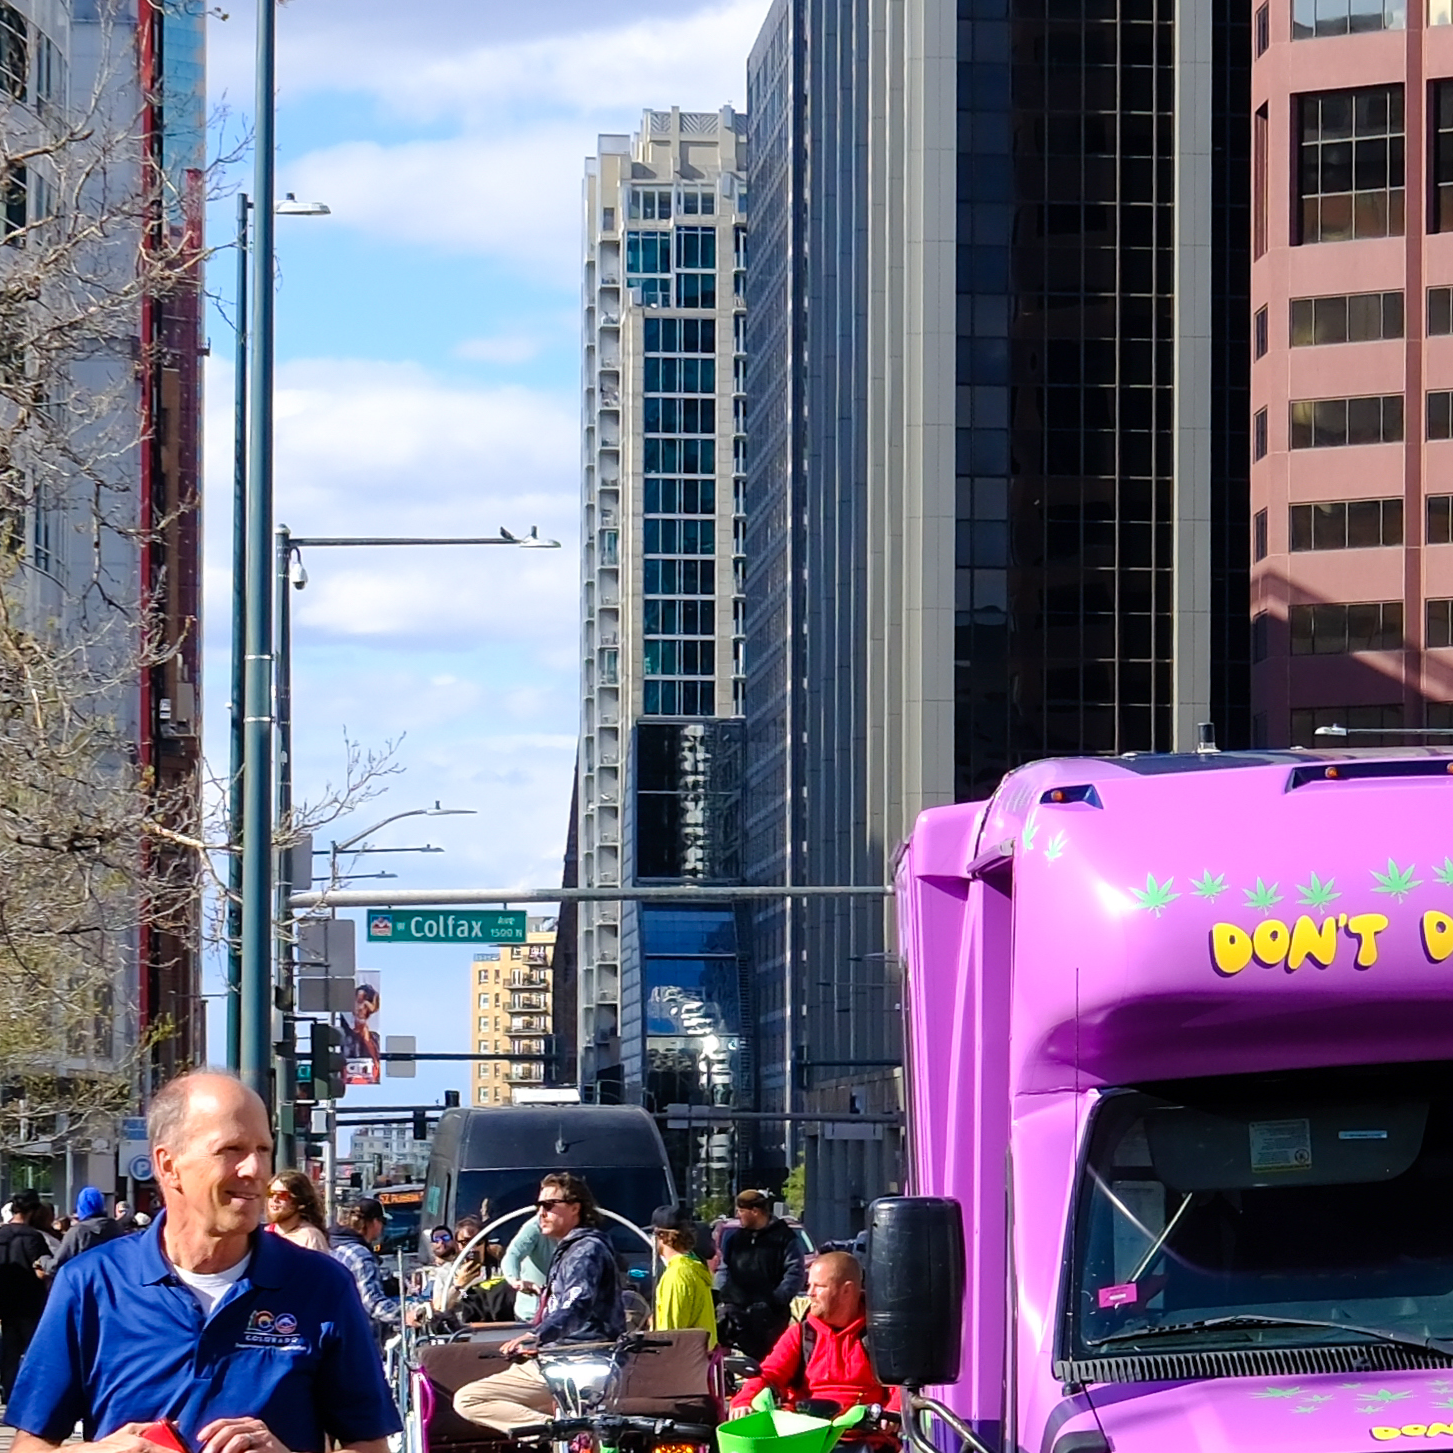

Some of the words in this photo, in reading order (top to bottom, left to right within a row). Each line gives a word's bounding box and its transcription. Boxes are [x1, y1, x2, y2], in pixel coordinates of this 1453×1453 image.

[410, 914, 483, 938] Colfax
[497, 916, 516, 926] Ave
[1210, 913, 1390, 976] DON'T
